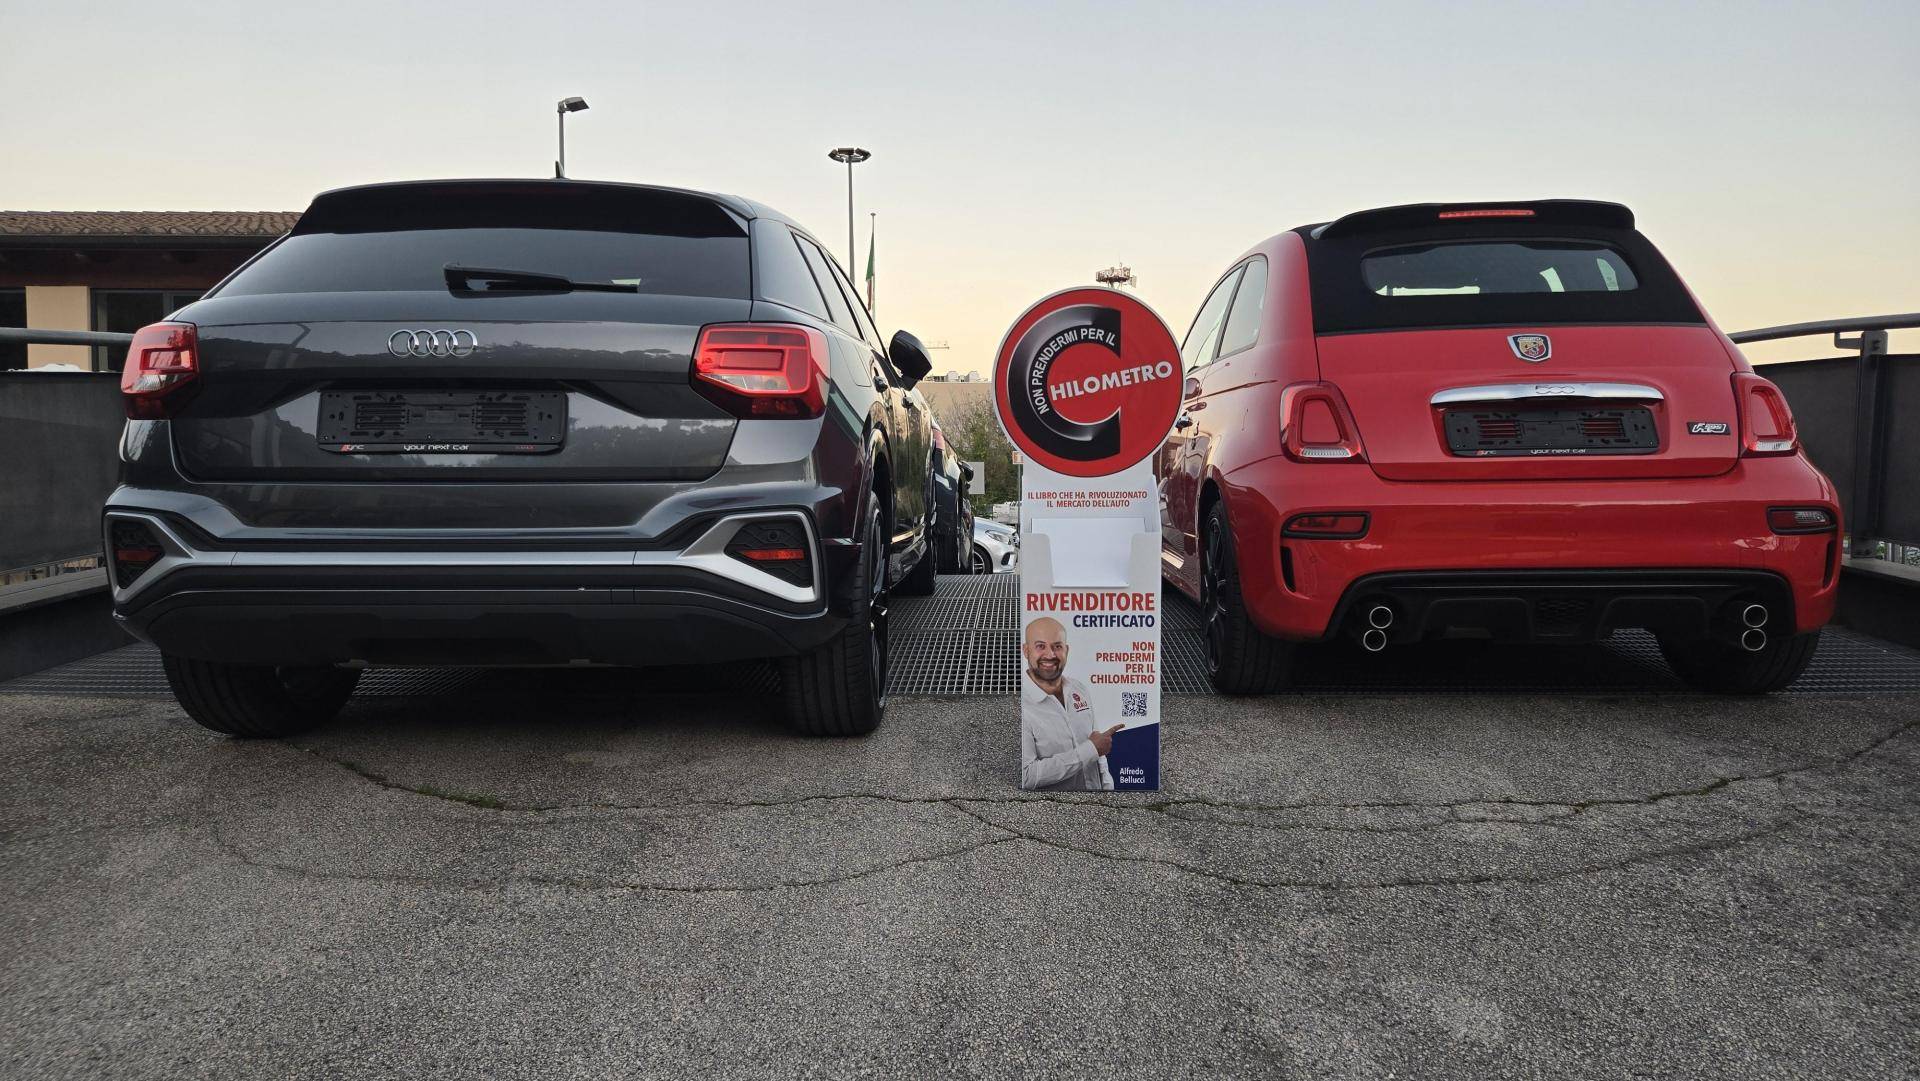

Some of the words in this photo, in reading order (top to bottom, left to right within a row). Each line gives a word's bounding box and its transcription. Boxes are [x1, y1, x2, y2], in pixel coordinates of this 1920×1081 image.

[1080, 328, 1104, 341] PER
[1105, 332, 1116, 346] IL
[1032, 330, 1078, 386] PRENDERMI
[1032, 389, 1049, 415] NON
[1027, 491, 1034, 500] IL
[1035, 491, 1057, 500] LIBRO
[1058, 491, 1073, 500] CHE
[1074, 491, 1086, 500] HA
[1088, 491, 1148, 499] RIVOLUZIONATO
[1056, 500, 1091, 508] MERCATO
[1092, 500, 1130, 508] DELL'AUTO
[1026, 592, 1155, 612] RIVENDITORE
[1073, 614, 1155, 628] CERTIFICATO
[1132, 641, 1155, 652] NON
[1096, 652, 1155, 662] PRENDERMI
[1125, 663, 1144, 673] PER
[1146, 663, 1156, 673] IL
[1090, 674, 1155, 684] CHILOMETRO
[1119, 767, 1144, 775] Alfredo
[1119, 776, 1146, 784] Bellucci
